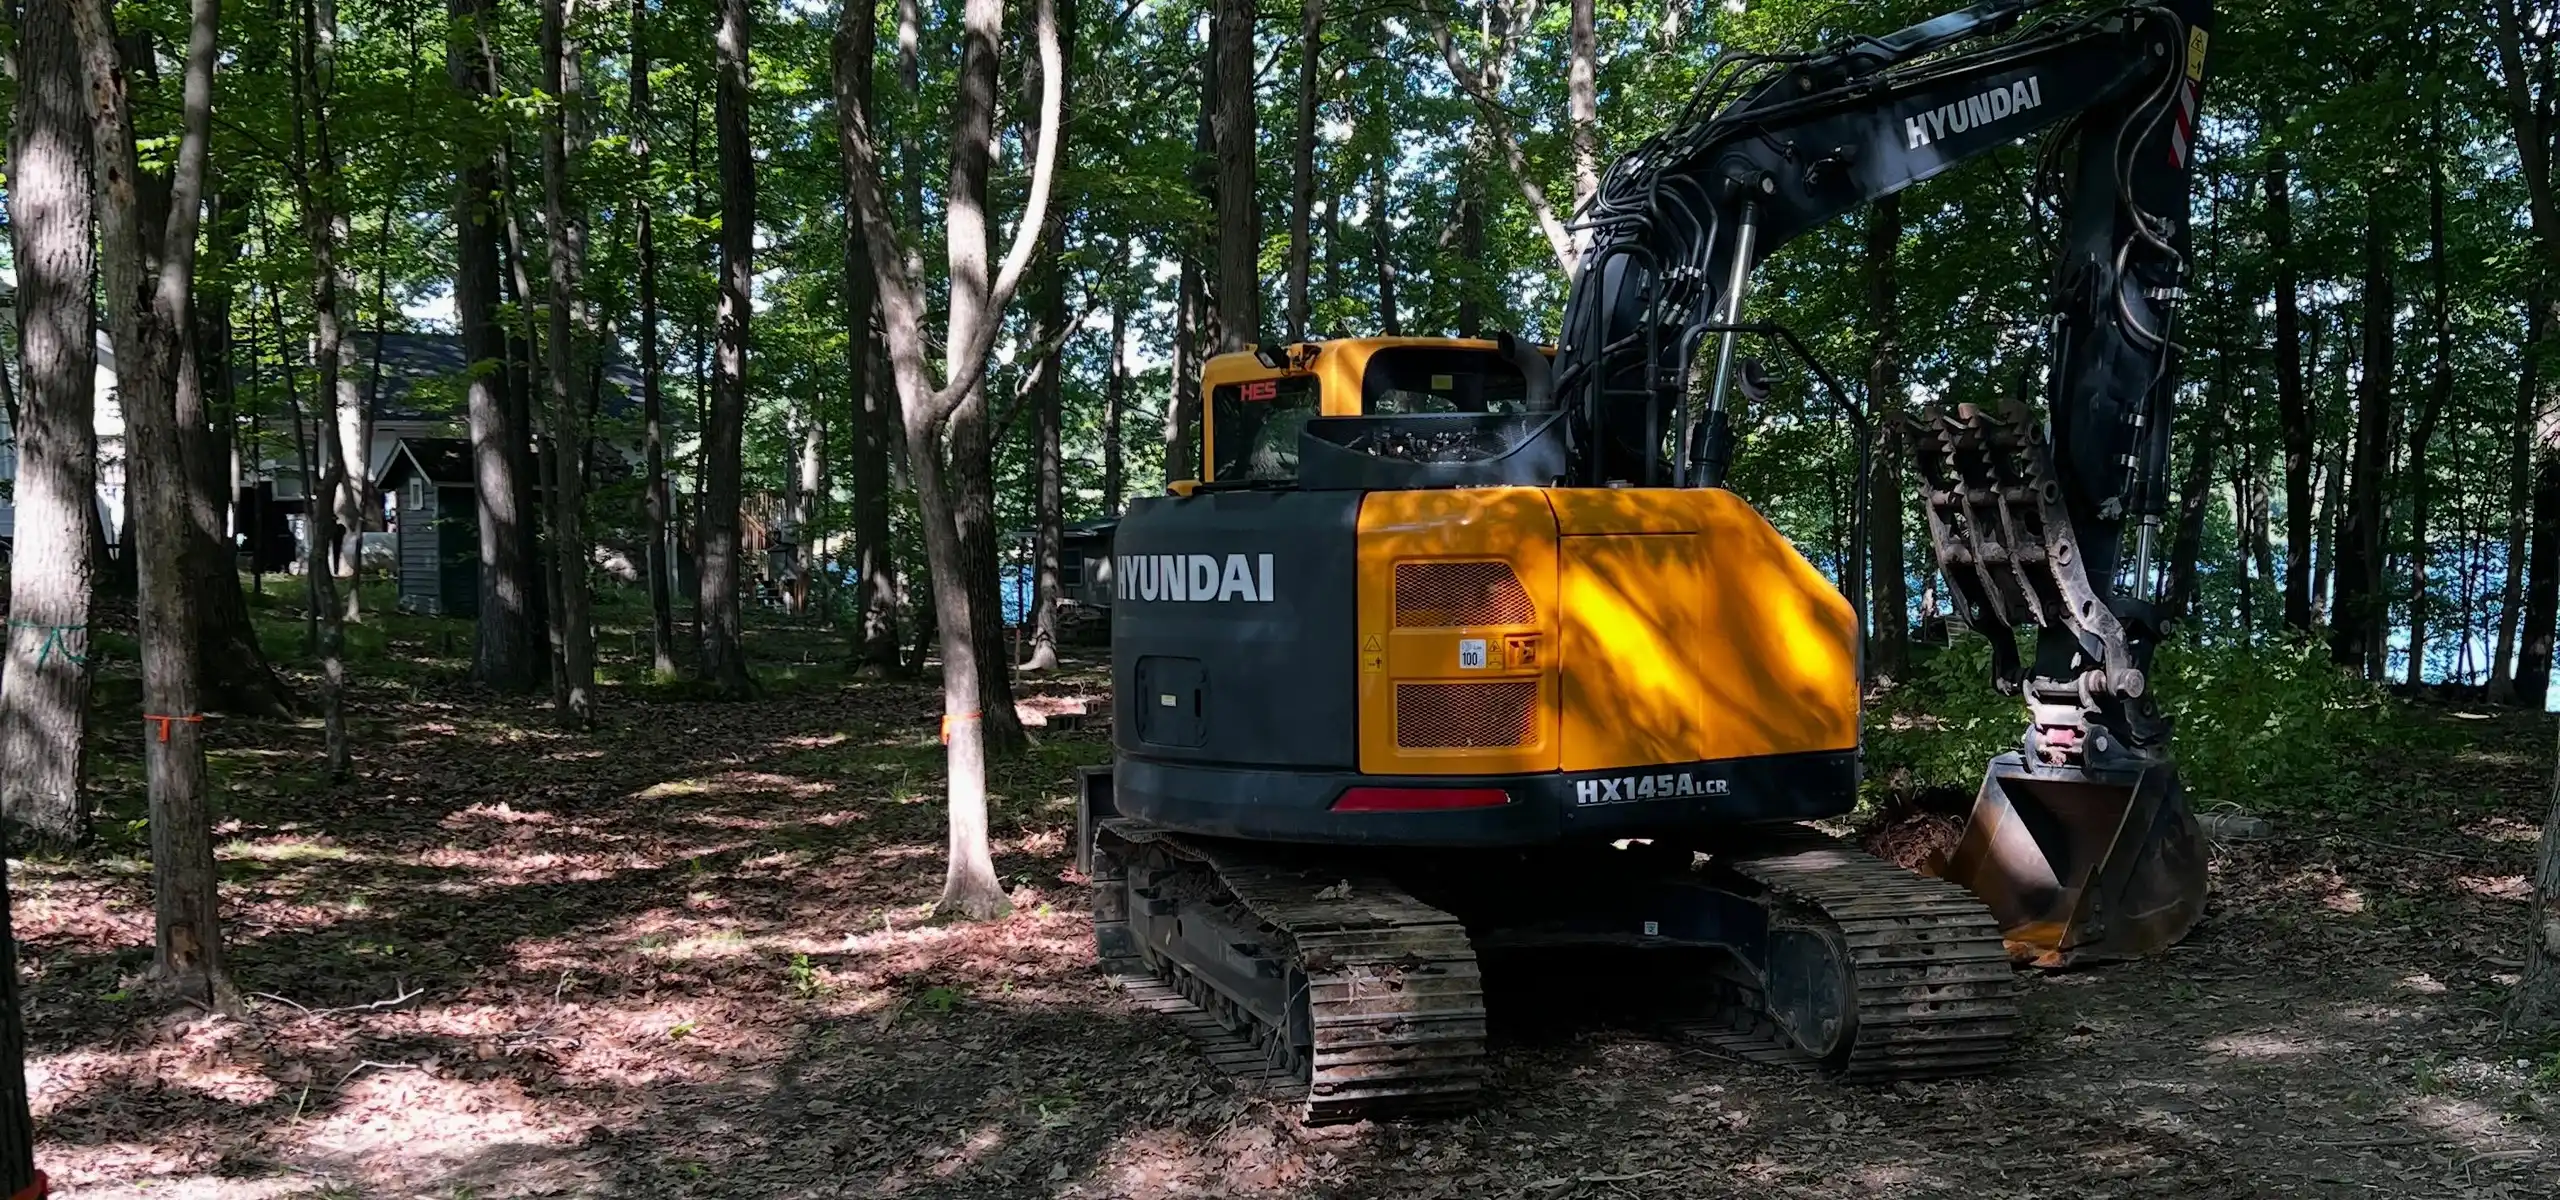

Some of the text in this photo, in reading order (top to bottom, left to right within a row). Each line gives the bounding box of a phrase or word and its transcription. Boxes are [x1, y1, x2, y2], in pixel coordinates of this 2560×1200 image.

[1905, 76, 2042, 150] HYUNDAI
[1240, 382, 1277, 401] HES
[1117, 553, 1274, 602] HYUNDAI
[1462, 652, 1478, 666] 100
